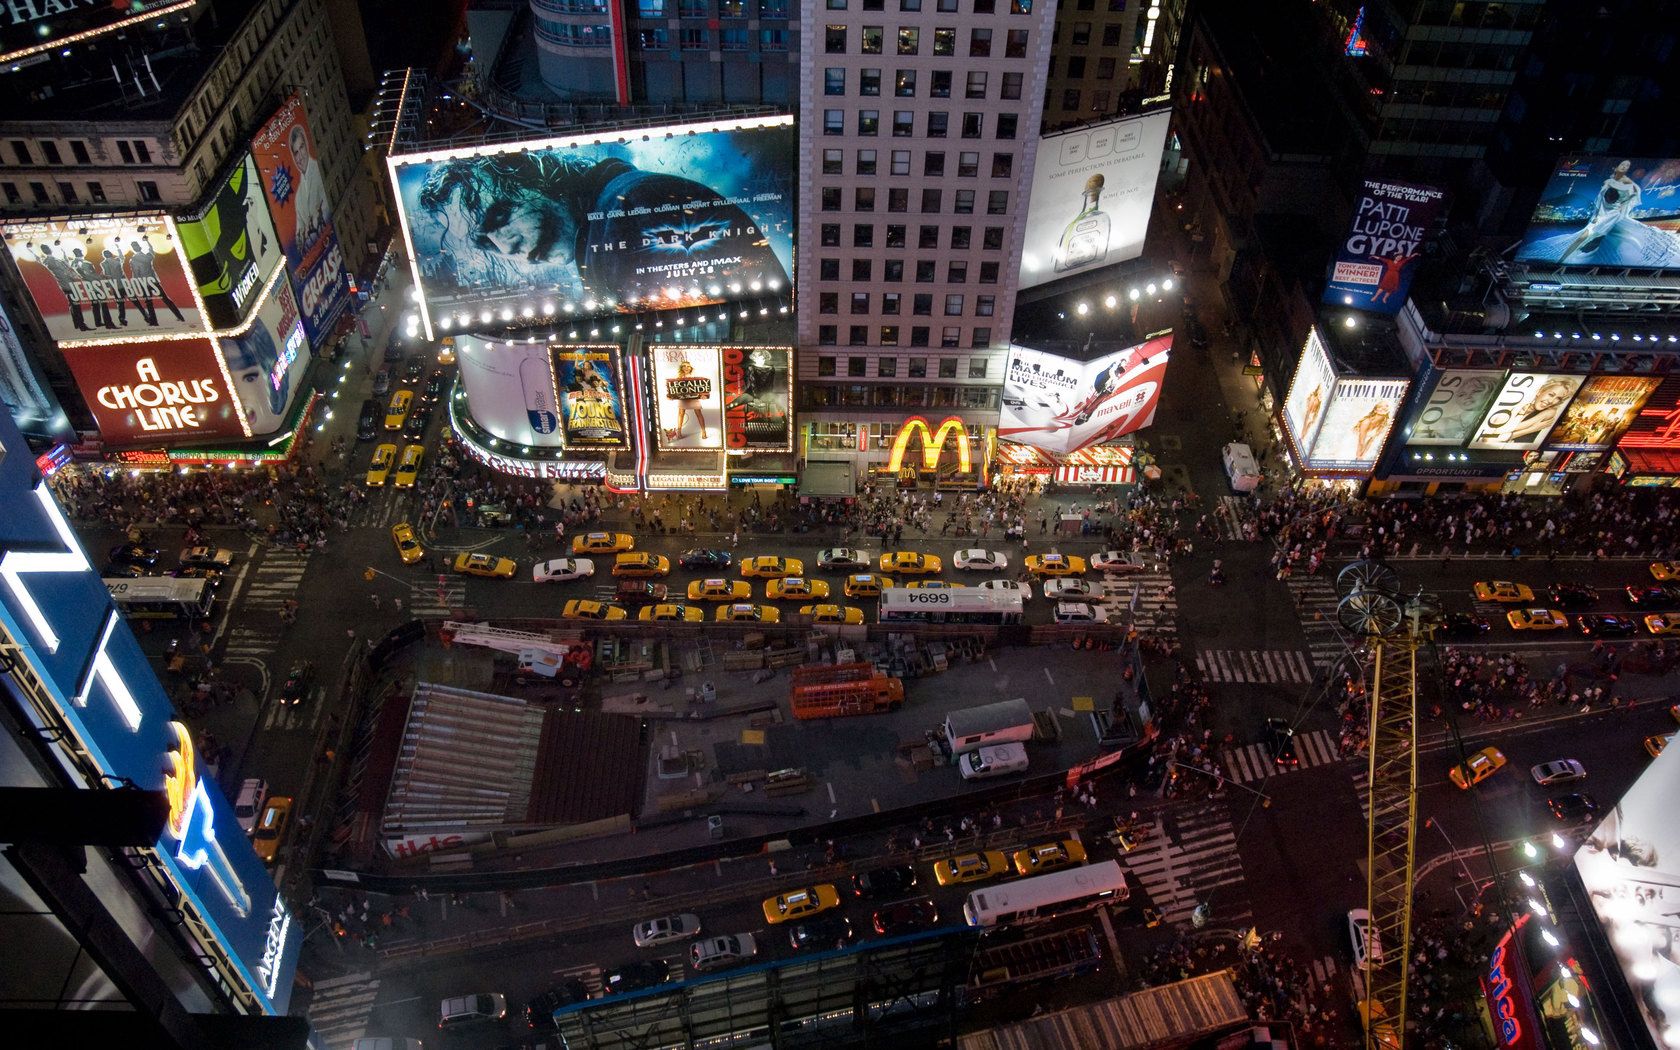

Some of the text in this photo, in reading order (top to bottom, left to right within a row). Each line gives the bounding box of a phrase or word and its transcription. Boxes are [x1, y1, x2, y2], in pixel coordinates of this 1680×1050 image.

[1067, 162, 1105, 177] PERFECTION
[1364, 180, 1443, 199] THE PERFORMANCE
[1387, 191, 1403, 199] THE
[1404, 194, 1429, 203] YEAR!
[627, 208, 652, 217] LEDGER
[654, 204, 680, 213] OLDMAN
[682, 201, 710, 210] ECKHART
[713, 197, 751, 207] GYLLENHAAL
[753, 194, 782, 202] FREEMAN
[1359, 197, 1409, 223] PATTI
[591, 223, 783, 252] THE DARK KNIGHT
[1346, 234, 1420, 257] GYPSY
[636, 255, 742, 275] IN THEATERS AND IMAX
[666, 265, 715, 279] JULY 18
[1337, 268, 1379, 279] WINNER!
[69, 276, 162, 301] JERSEY BOYS
[302, 244, 342, 317] GREASE
[136, 358, 160, 382] A
[668, 379, 710, 388] LEGALLY
[669, 386, 711, 395] BLONDE
[1010, 374, 1048, 390] LIVES
[97, 379, 219, 409] CHORUS
[568, 401, 616, 420] YOUNG
[1096, 398, 1133, 418] maxell
[1411, 375, 1462, 439] TOUS
[1475, 375, 1535, 443] TOUS
[135, 405, 199, 430] LINE
[568, 418, 622, 432] FRANKENSTEIN
[1416, 467, 1483, 476] OPPORTUNITY
[908, 592, 950, 604] 6694
